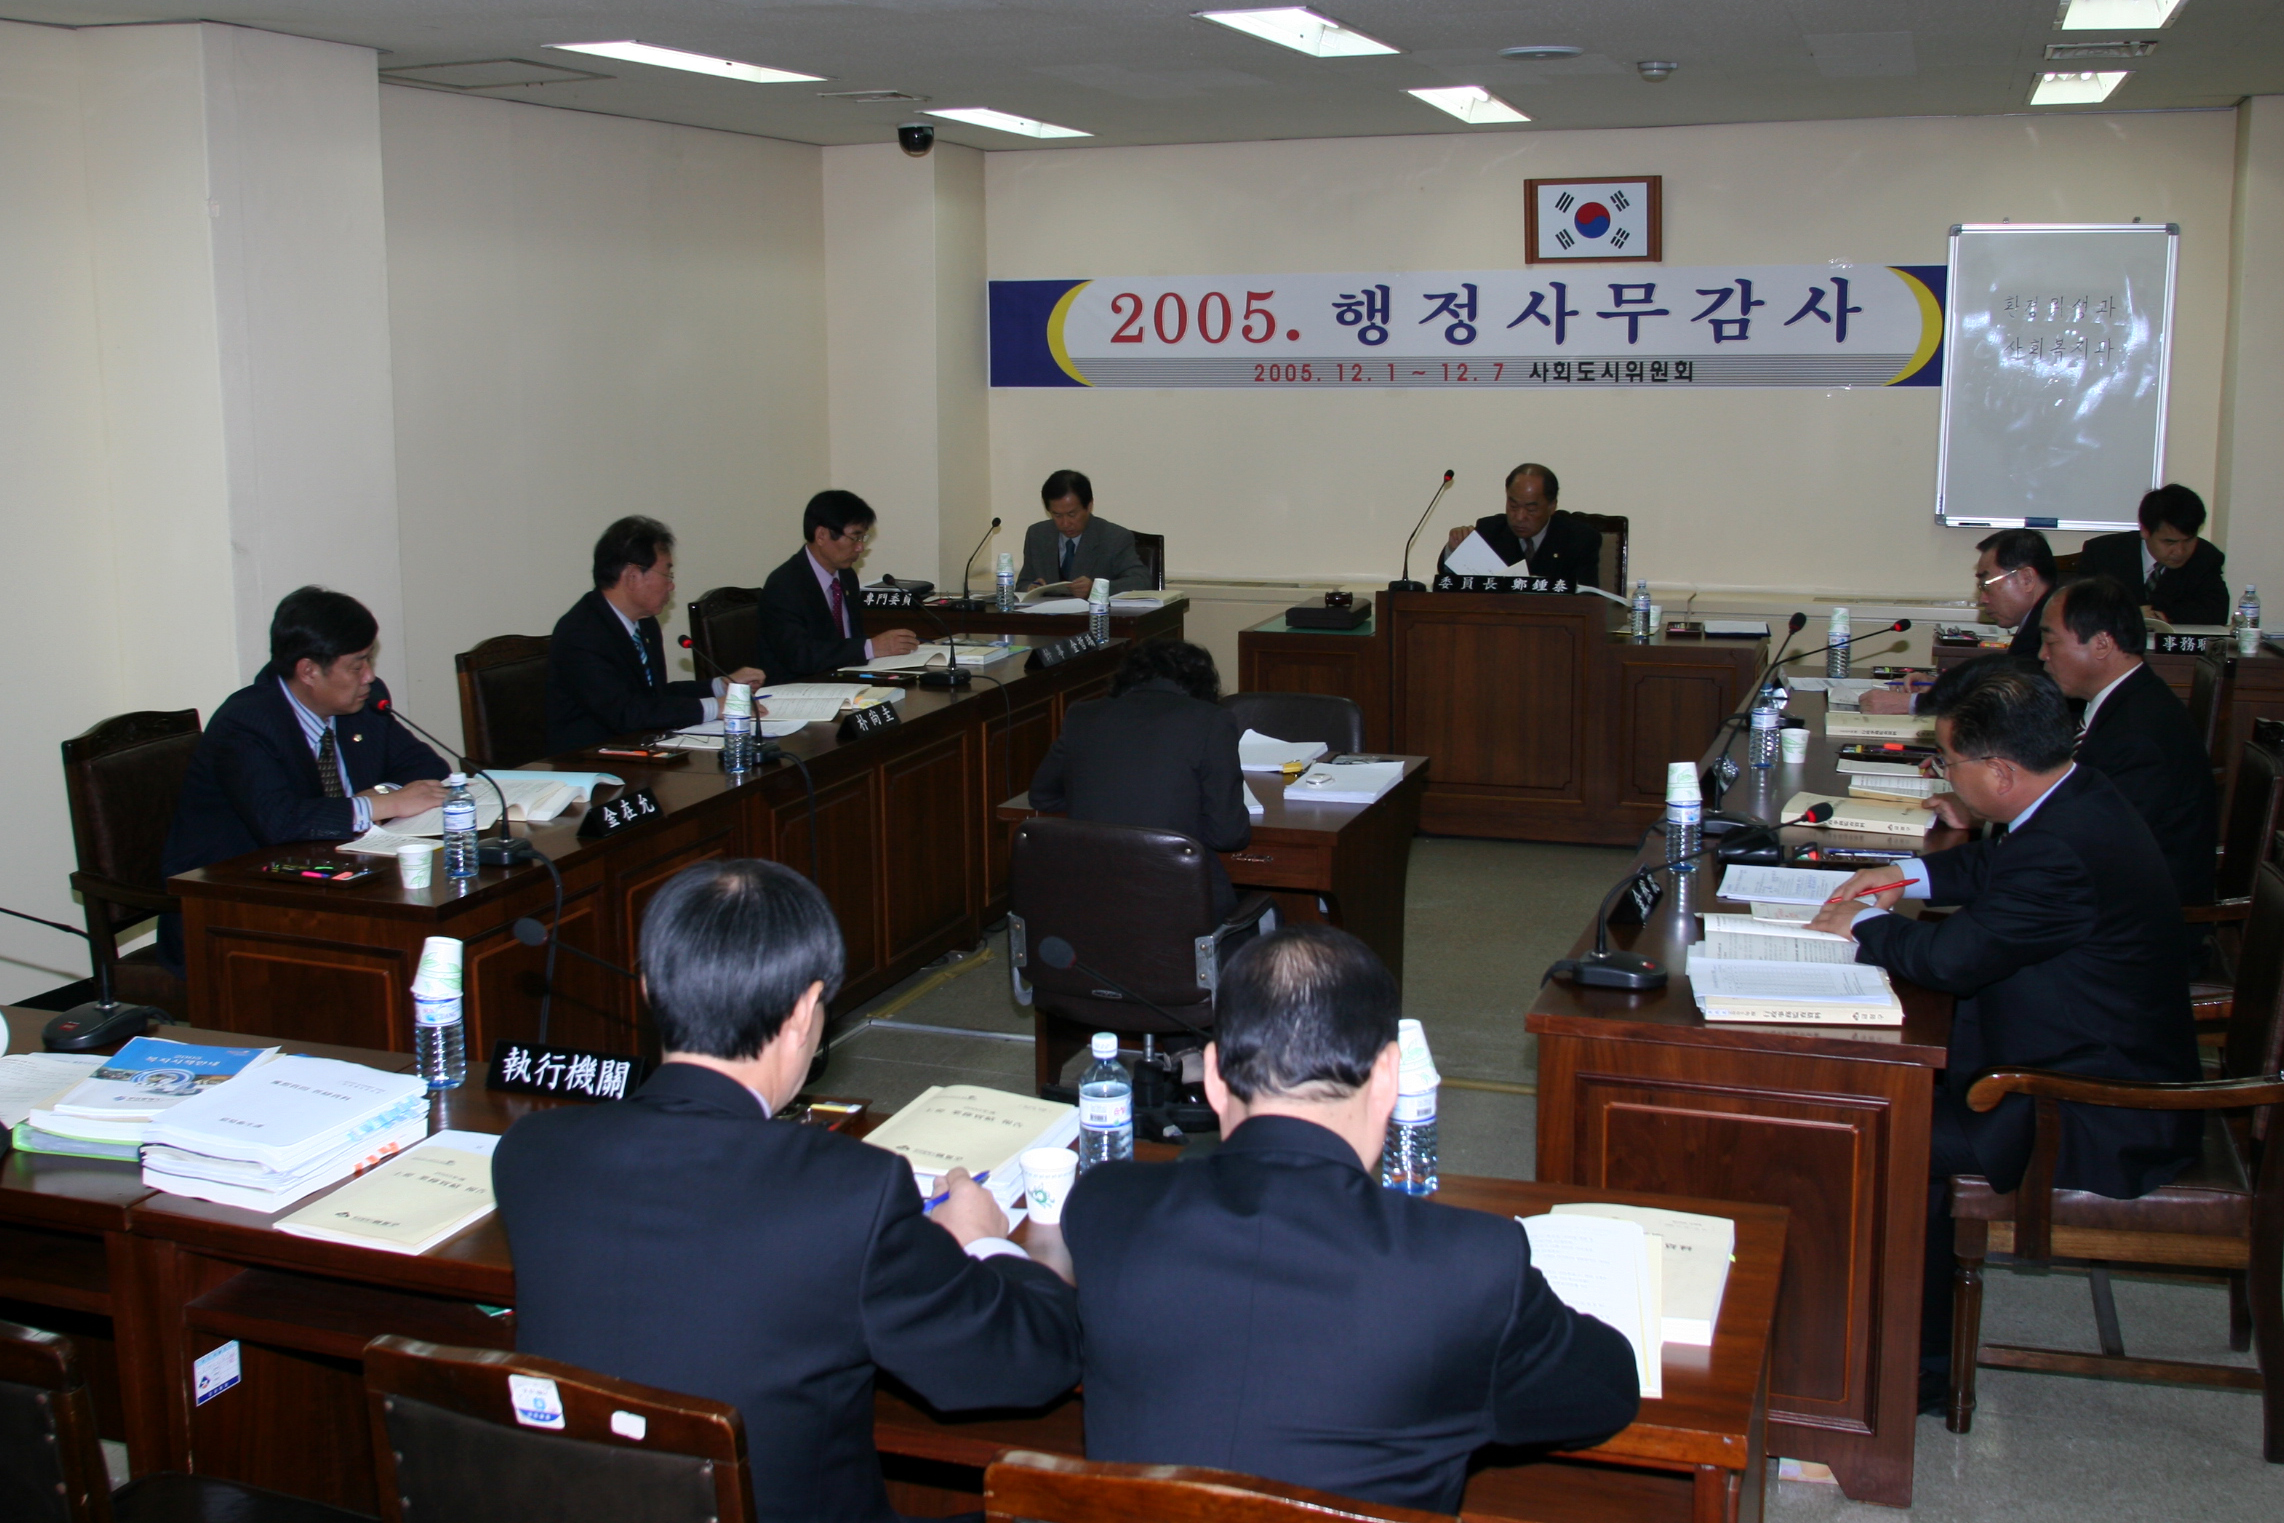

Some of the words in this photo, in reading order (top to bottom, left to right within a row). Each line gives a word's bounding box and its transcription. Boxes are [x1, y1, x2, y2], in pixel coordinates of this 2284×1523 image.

[1110, 290, 1301, 344] 2005.
[1332, 276, 1863, 347] 행정사무감사
[1254, 363, 1321, 382] 2005.
[1336, 363, 1372, 382] 12.
[1386, 363, 1397, 382] 1
[1441, 362, 1477, 382] 12.
[1493, 362, 1505, 382] 7
[1529, 360, 1694, 383] 사회도시위원회
[1438, 576, 1498, 590] 委員長
[602, 793, 656, 829] 金在允
[500, 1046, 631, 1101] 執行機關
